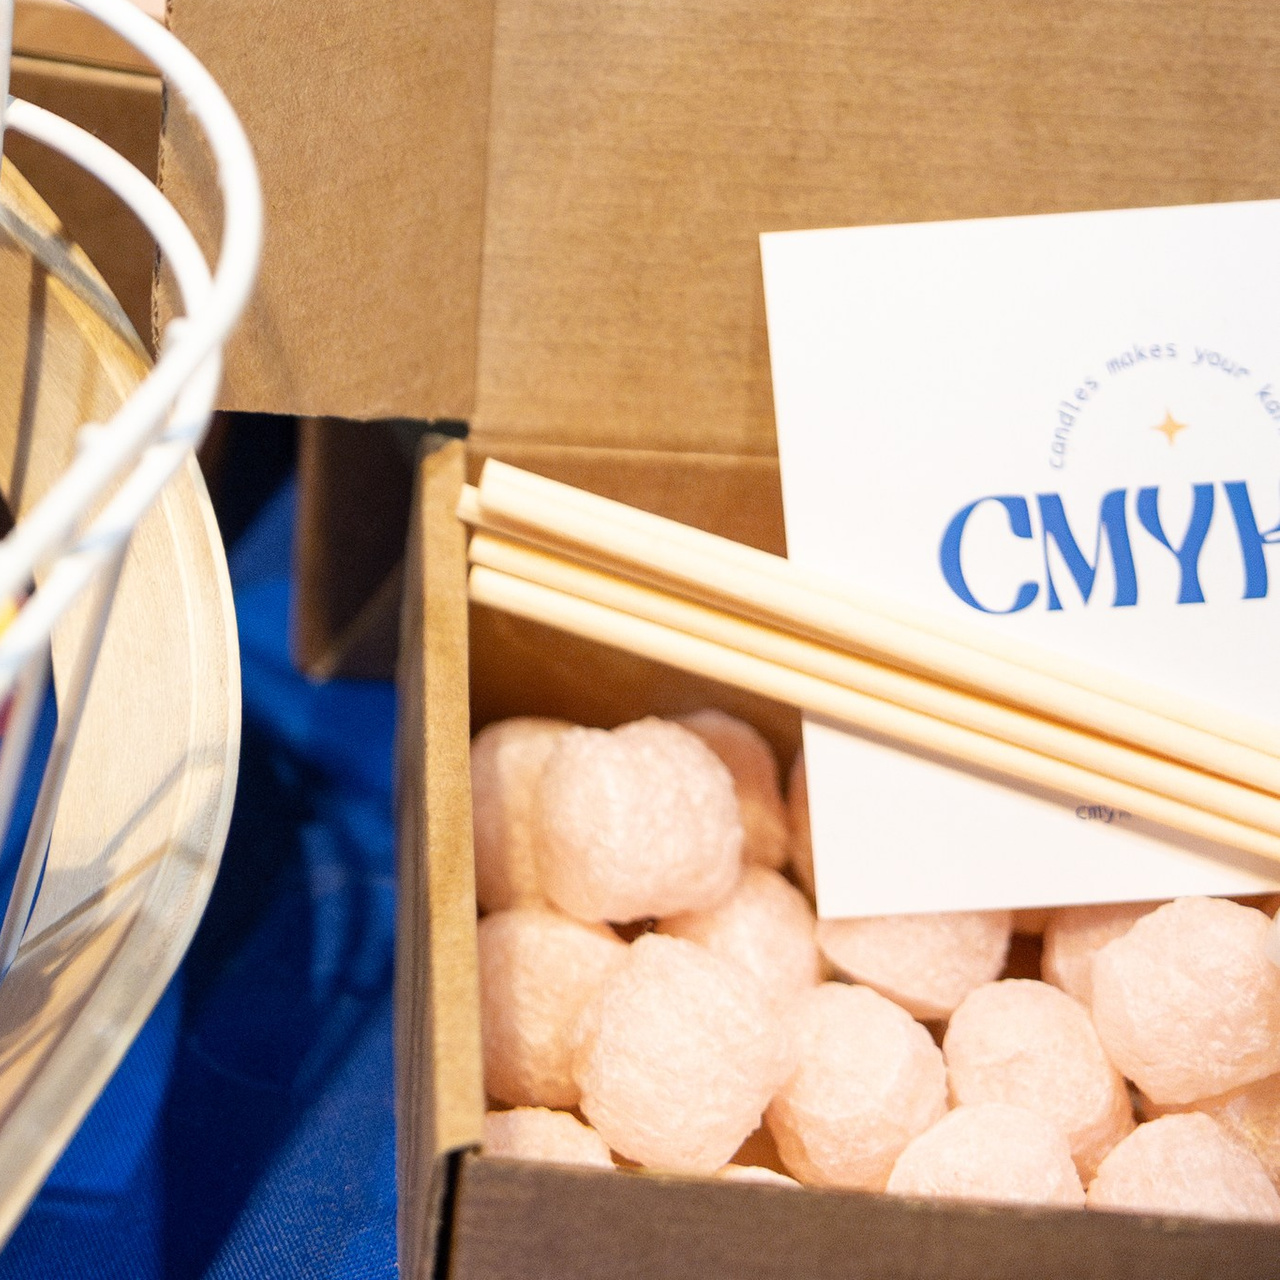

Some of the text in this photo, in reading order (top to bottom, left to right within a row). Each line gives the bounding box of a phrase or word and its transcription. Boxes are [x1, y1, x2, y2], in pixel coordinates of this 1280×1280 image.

[1048, 376, 1099, 470] candles
[1106, 342, 1178, 375] makes
[1192, 345, 1250, 378] your
